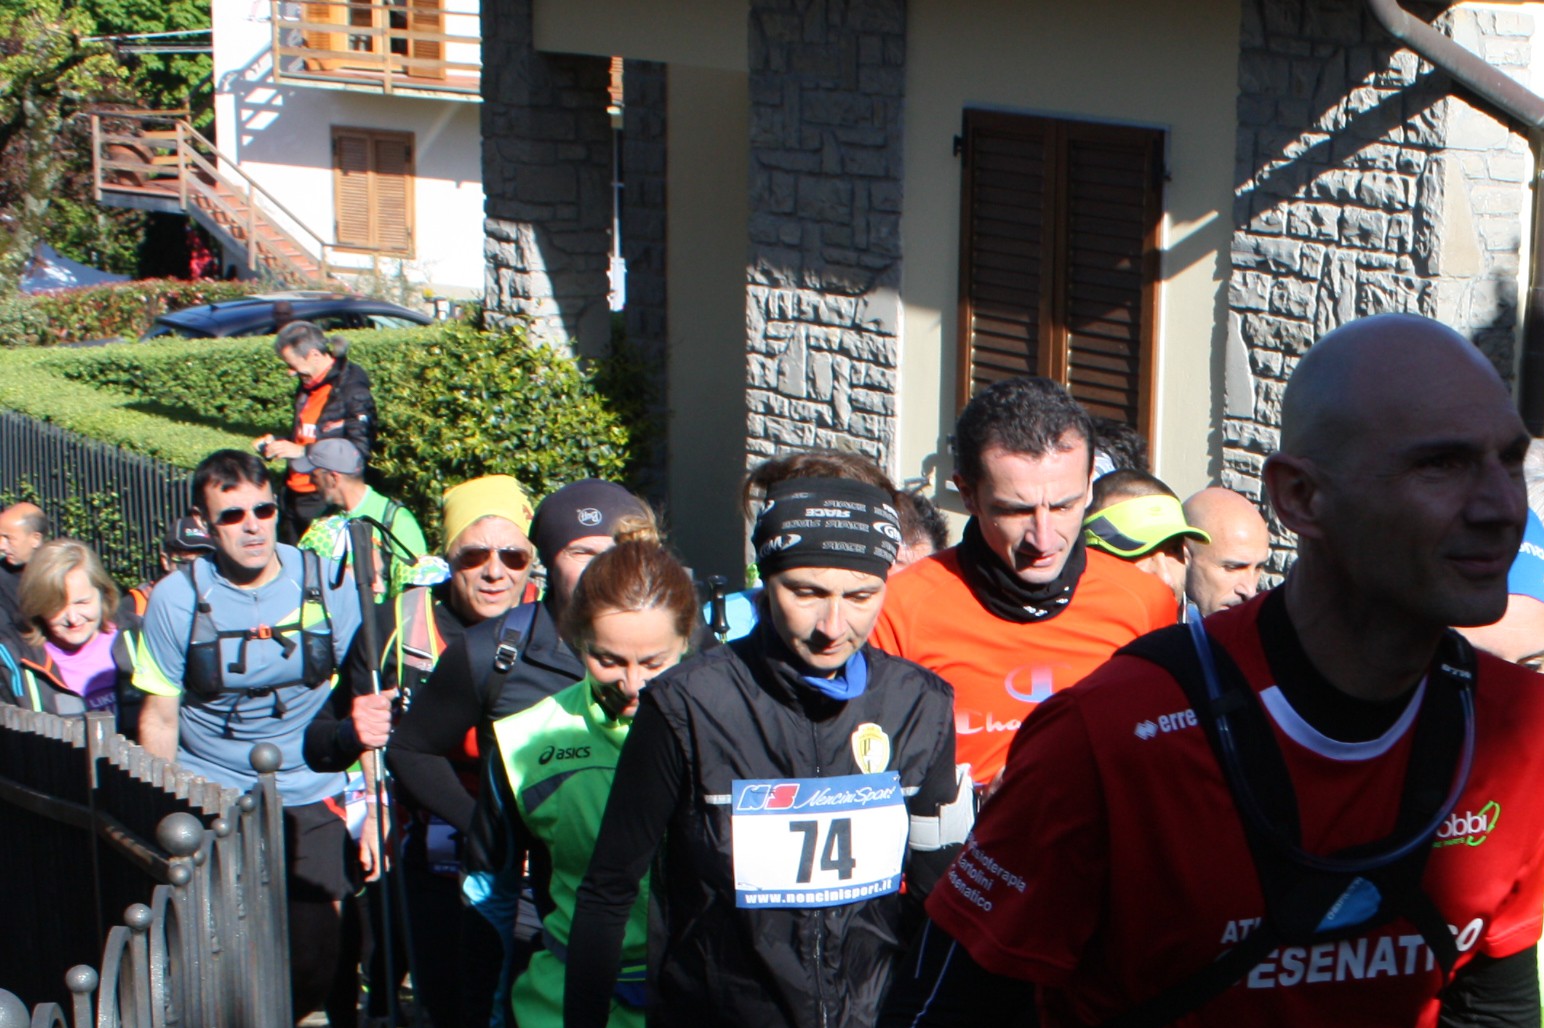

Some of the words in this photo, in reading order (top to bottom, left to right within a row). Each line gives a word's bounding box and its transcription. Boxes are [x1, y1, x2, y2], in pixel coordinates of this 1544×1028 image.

[954, 709, 1022, 735] Cha
[1158, 707, 1197, 733] erre
[555, 745, 592, 761] asics
[789, 817, 857, 884] 74
[744, 878, 893, 905] www.nencinisport.it
[1214, 917, 1484, 989] ESENATIO
